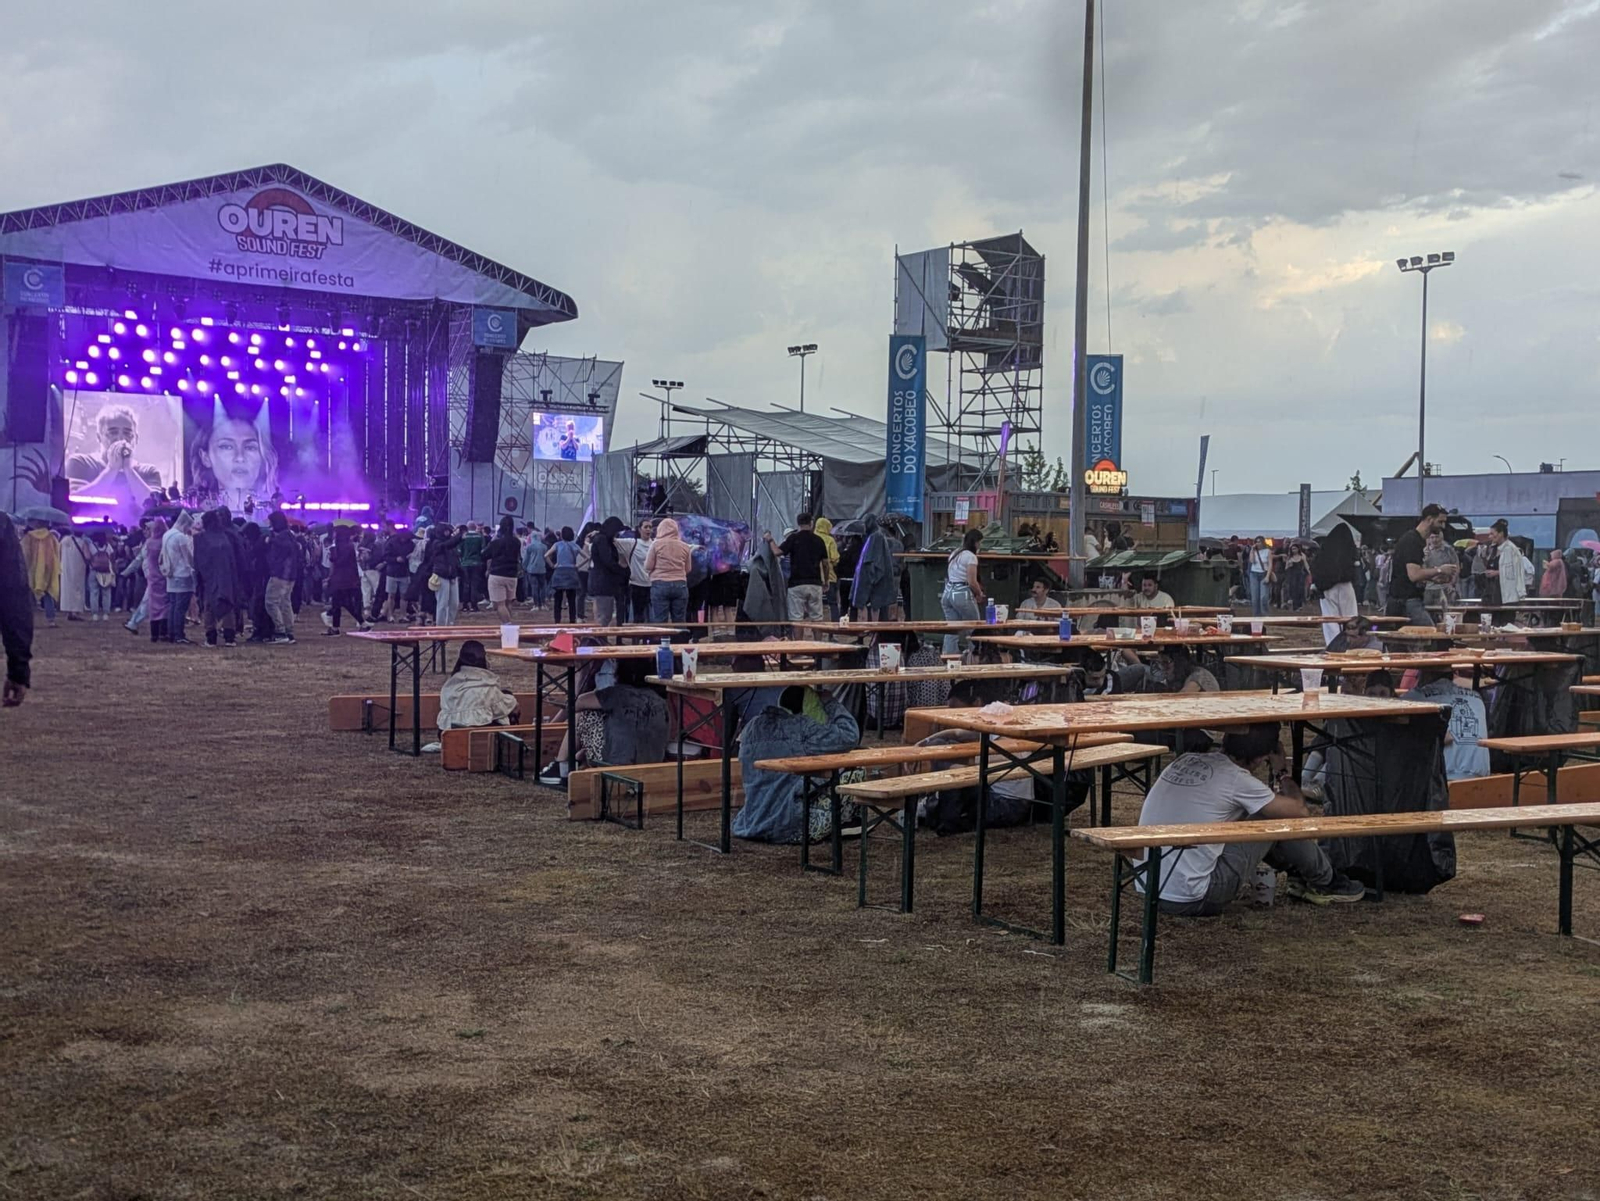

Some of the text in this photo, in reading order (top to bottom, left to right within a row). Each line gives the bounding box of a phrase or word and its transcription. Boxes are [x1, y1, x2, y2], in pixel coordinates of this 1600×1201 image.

[218, 203, 344, 246] OUREN
[236, 235, 326, 260] SOUND FEST
[208, 258, 355, 288] #aprimeirafesta
[891, 390, 904, 474] CONCERTOS
[903, 389, 917, 474] DO XACOBEO
[1091, 404, 1102, 464] NCERTOS
[1084, 470, 1127, 486] OUREN
[1090, 485, 1121, 494] SOUND FEST
